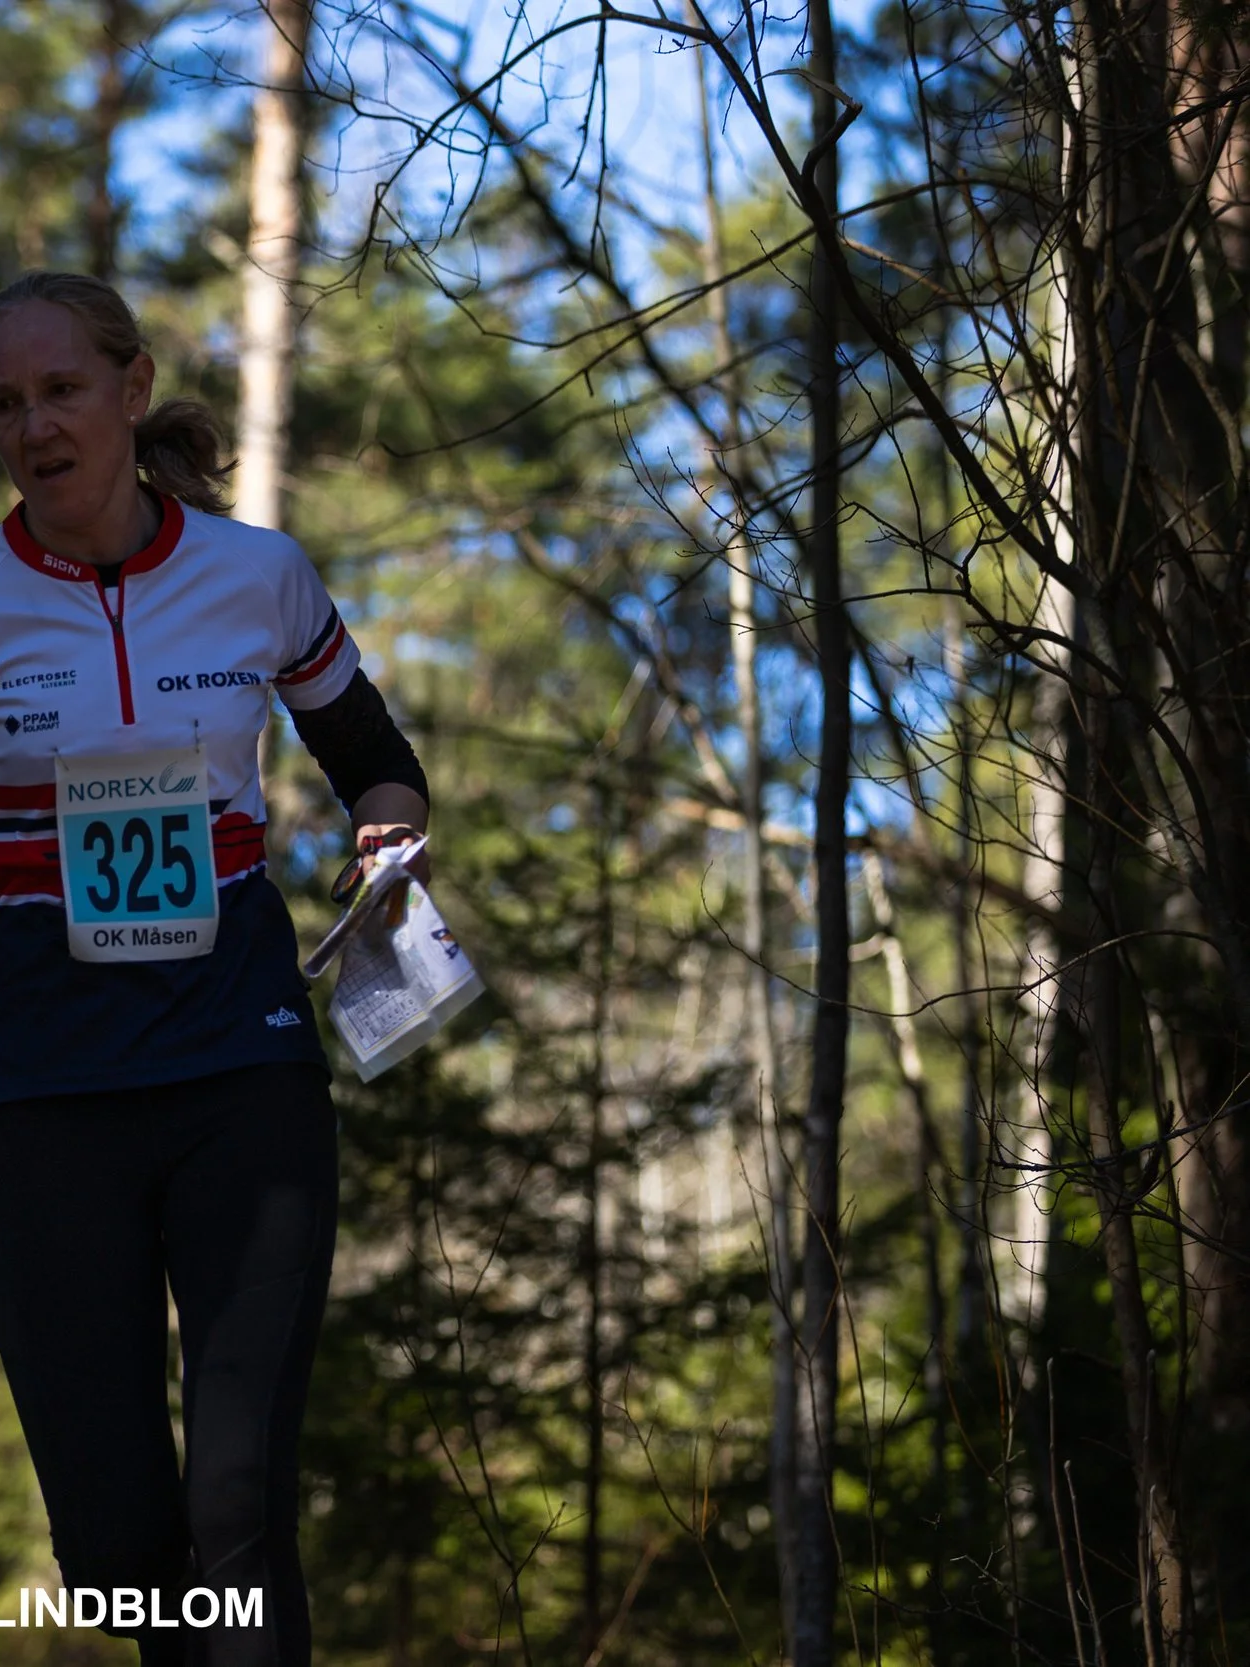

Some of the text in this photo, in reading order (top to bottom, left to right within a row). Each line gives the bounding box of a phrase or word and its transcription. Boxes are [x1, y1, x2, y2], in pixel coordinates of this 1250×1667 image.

[2, 670, 77, 690] ELECTROSEC
[157, 671, 261, 692] OK ROXEN
[22, 710, 59, 725] PPAM
[67, 776, 155, 802] NOREX
[83, 814, 197, 914] 325
[93, 926, 197, 947] OK Måsen
